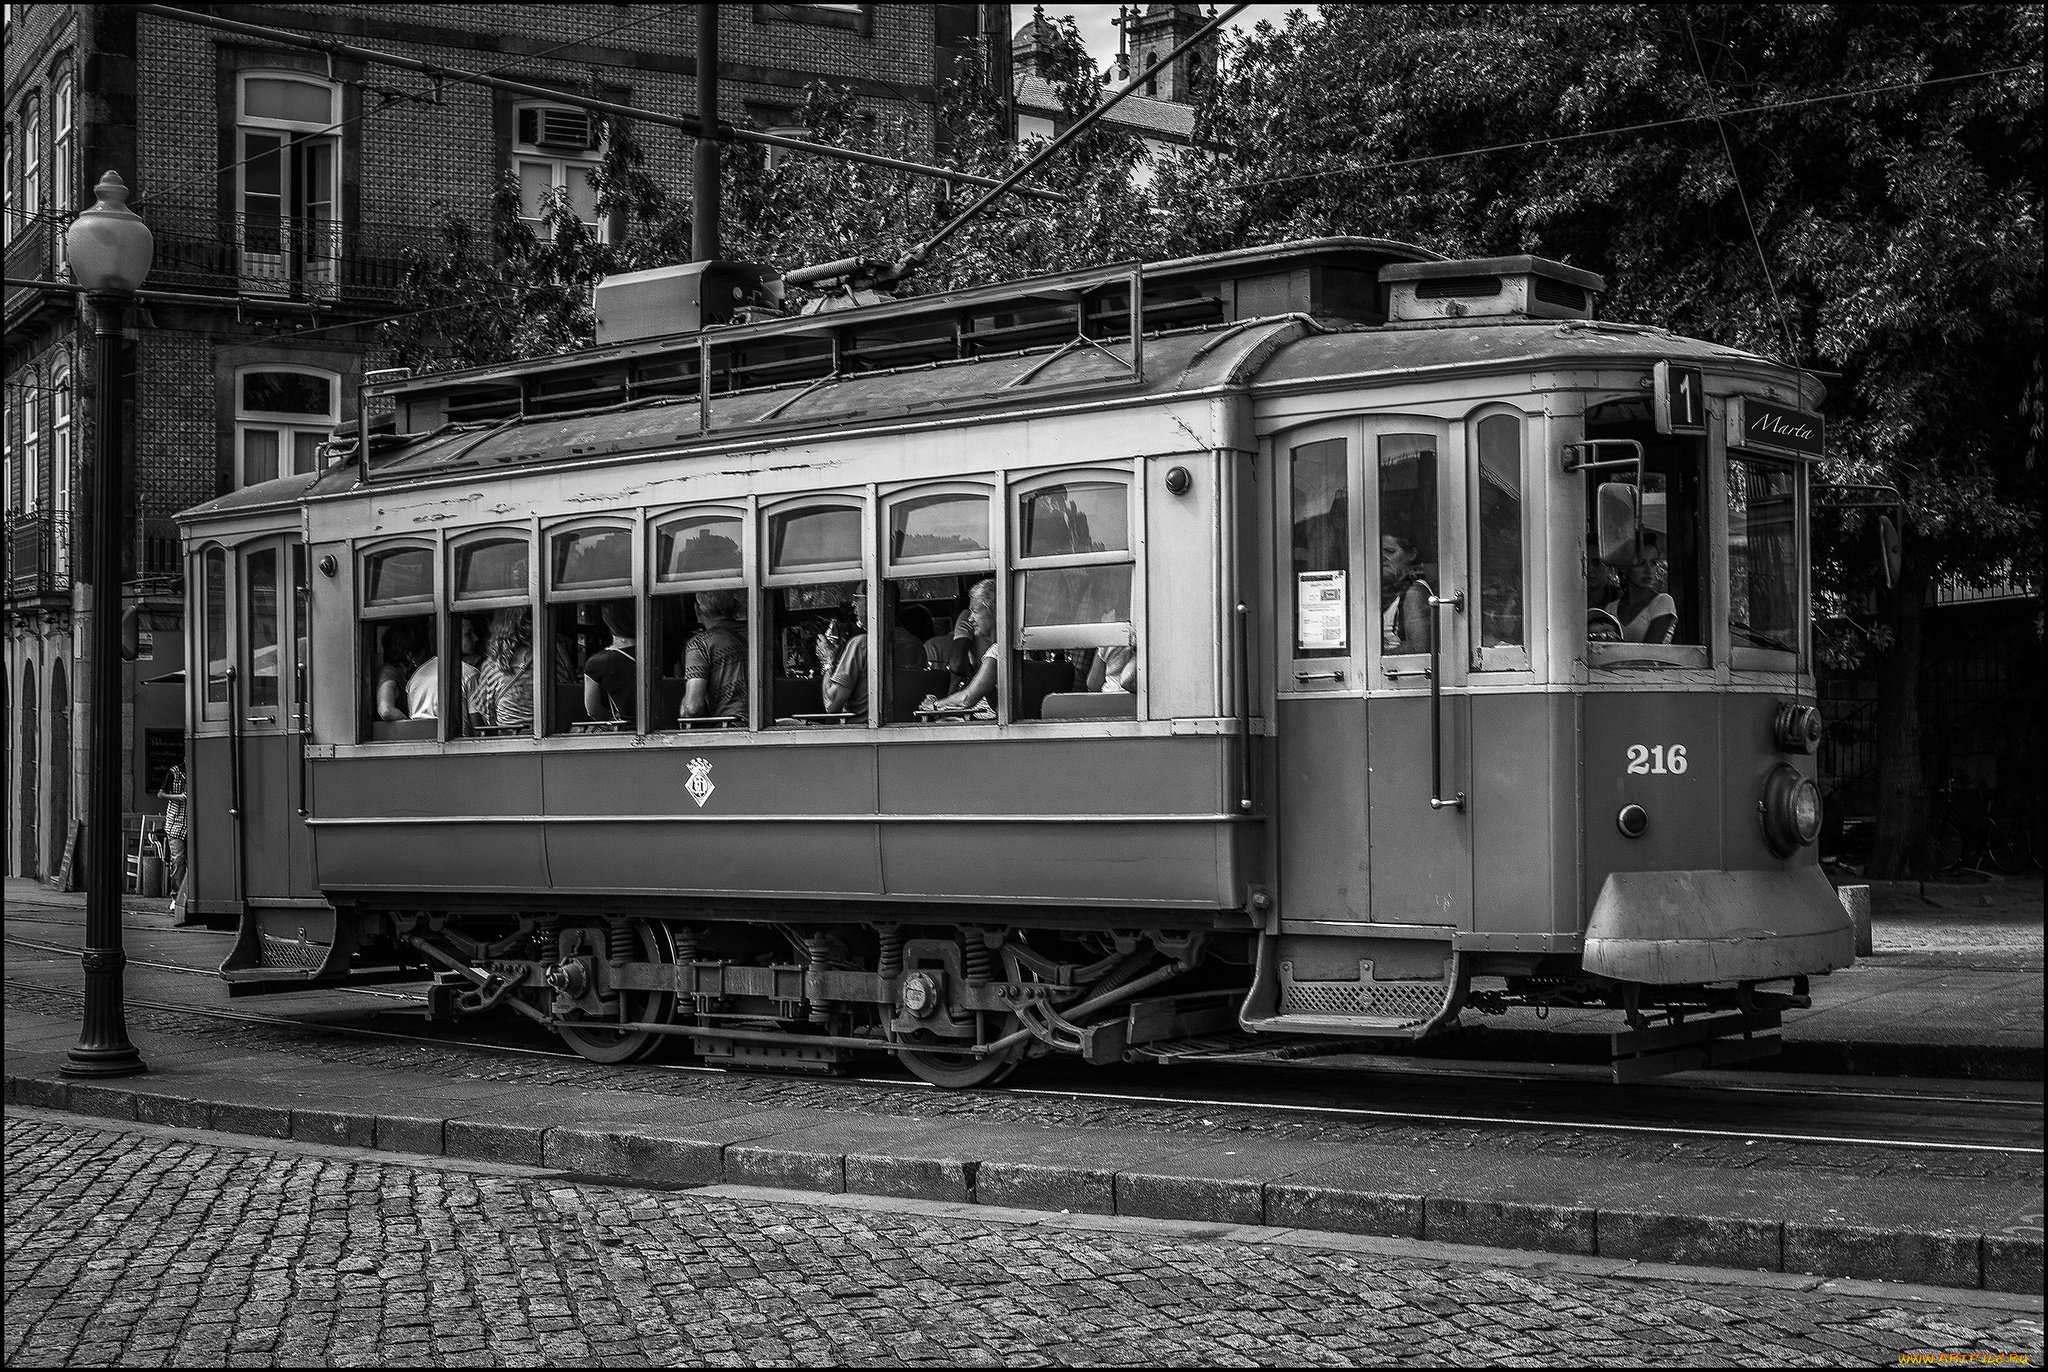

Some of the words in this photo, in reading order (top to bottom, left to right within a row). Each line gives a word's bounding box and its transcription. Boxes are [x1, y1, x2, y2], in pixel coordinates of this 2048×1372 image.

[1680, 373, 1693, 423] 1
[1751, 413, 1815, 440] Marta
[1627, 744, 1688, 775] 216
